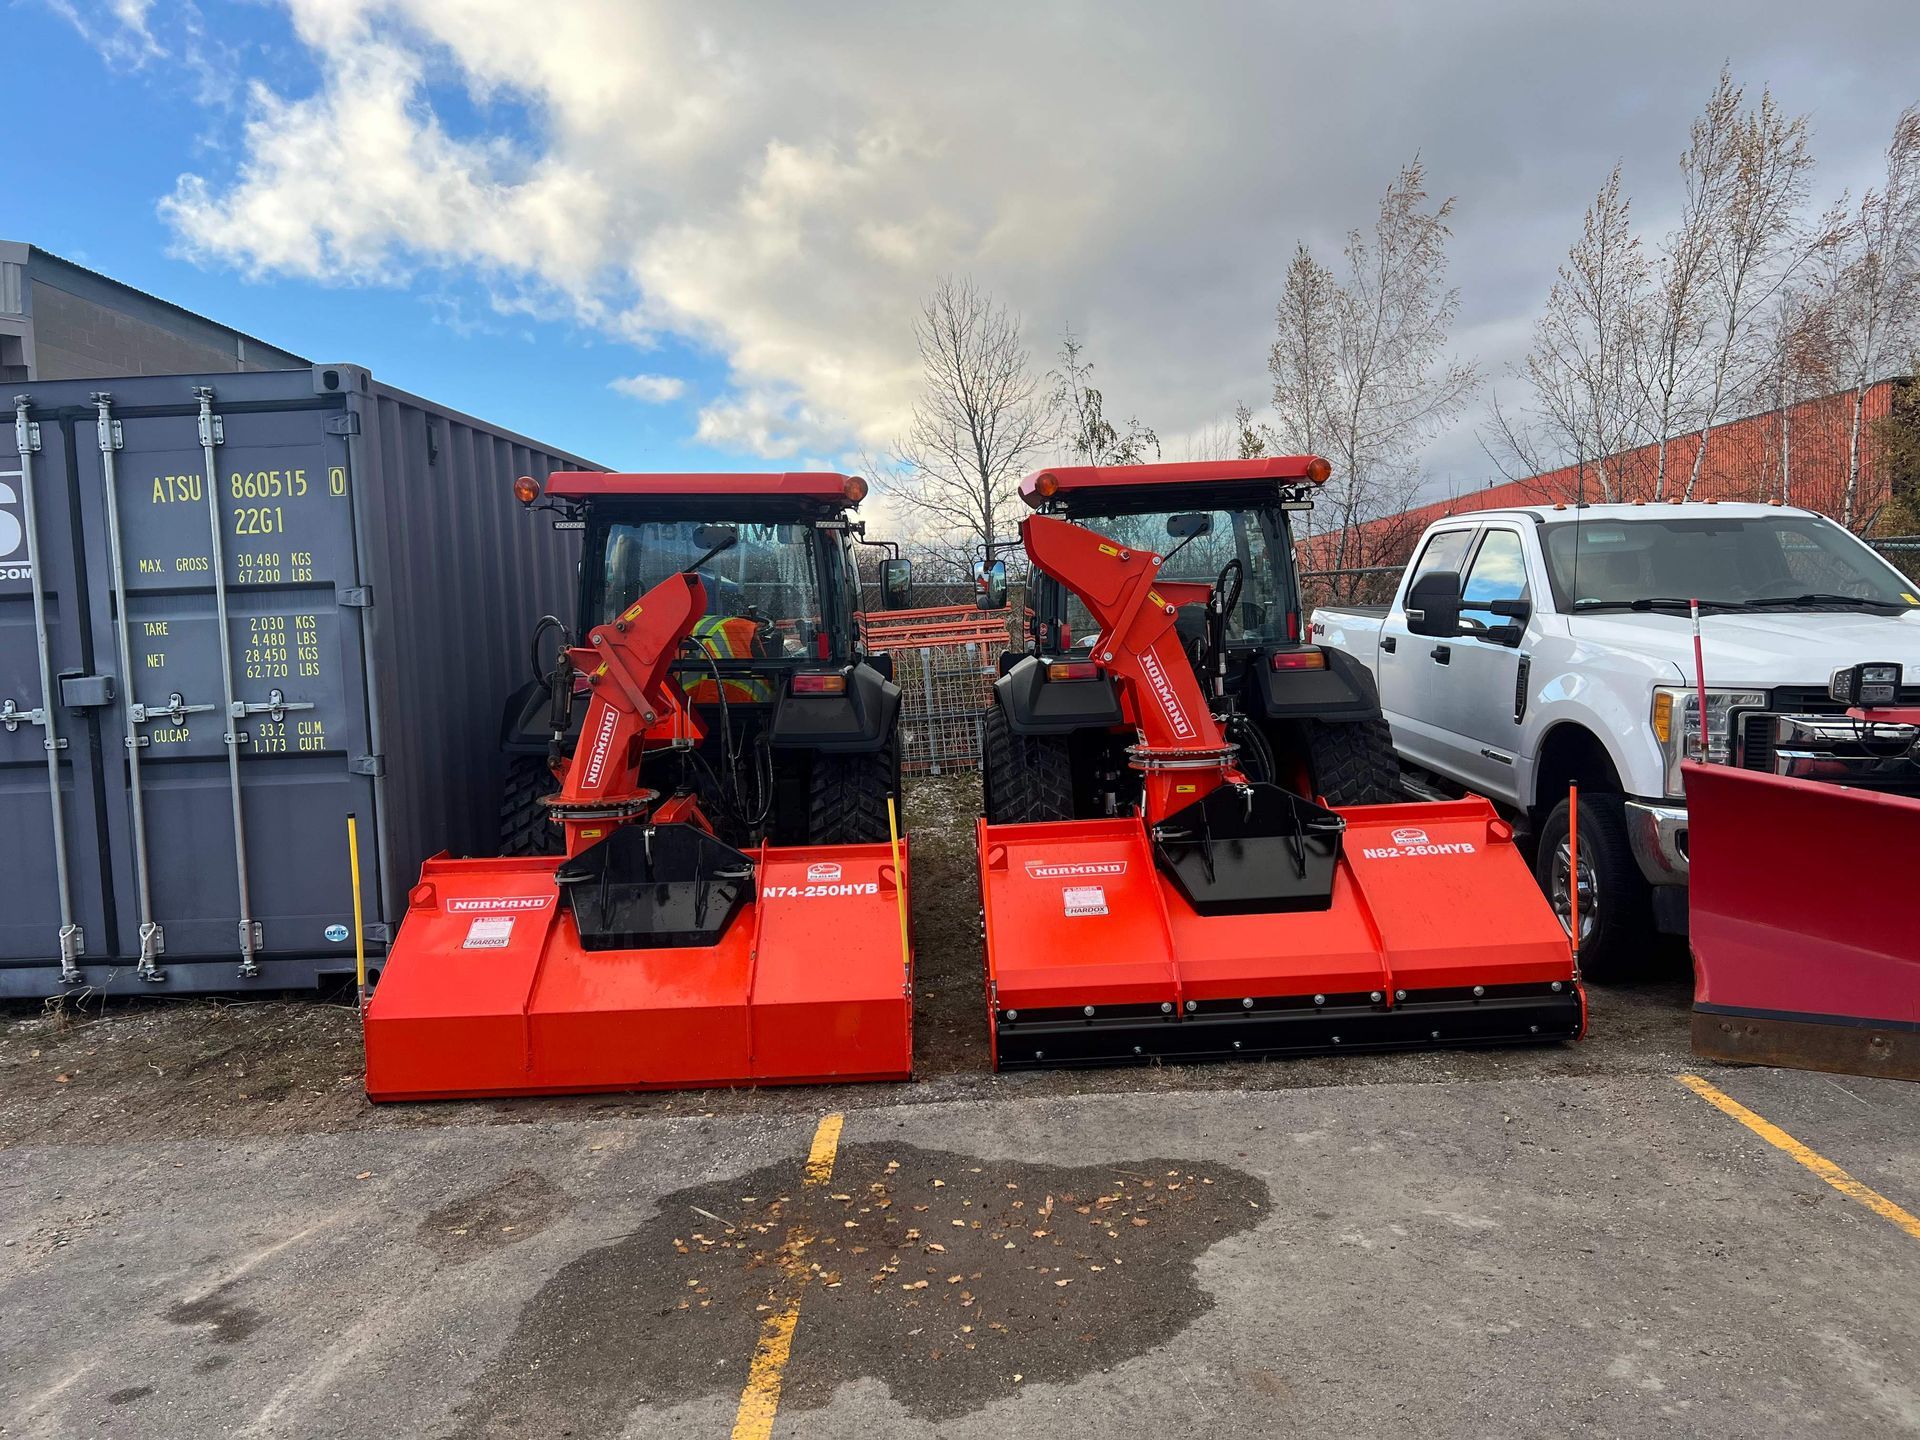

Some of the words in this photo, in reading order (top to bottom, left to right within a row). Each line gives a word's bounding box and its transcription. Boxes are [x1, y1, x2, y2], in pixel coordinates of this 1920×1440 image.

[153, 475, 202, 503] ATSU
[231, 470, 308, 499] 860515
[331, 469, 344, 495] 0
[234, 507, 283, 534] 22G1
[140, 559, 165, 573] MAX.
[176, 557, 208, 572] GROSS
[238, 553, 280, 567] 30.480
[291, 552, 311, 566] KGS
[239, 569, 280, 583] 67.200
[292, 569, 312, 582] LBS
[144, 622, 168, 636] TARE
[250, 616, 284, 631] 2.030
[295, 615, 316, 629] KGS
[252, 632, 285, 646] 4.480
[297, 631, 317, 645] LBS
[147, 654, 164, 668] NET
[245, 648, 287, 663] 28.450
[298, 647, 319, 660] KGS
[247, 664, 288, 678] 62.720
[300, 663, 320, 676] LBS
[1142, 654, 1188, 734] NORMAND
[154, 728, 191, 743] CU.CAP.
[259, 723, 285, 736] 33.2
[298, 721, 325, 735] CU.M.
[254, 738, 286, 752] 1.173
[299, 737, 326, 750] CU.FT.
[588, 711, 615, 783] NORMAND
[1363, 843, 1475, 859] N82-260HYB
[1035, 864, 1121, 876] NORMAND
[763, 883, 878, 897] N74-250HYB
[454, 899, 544, 910] NORMAND
